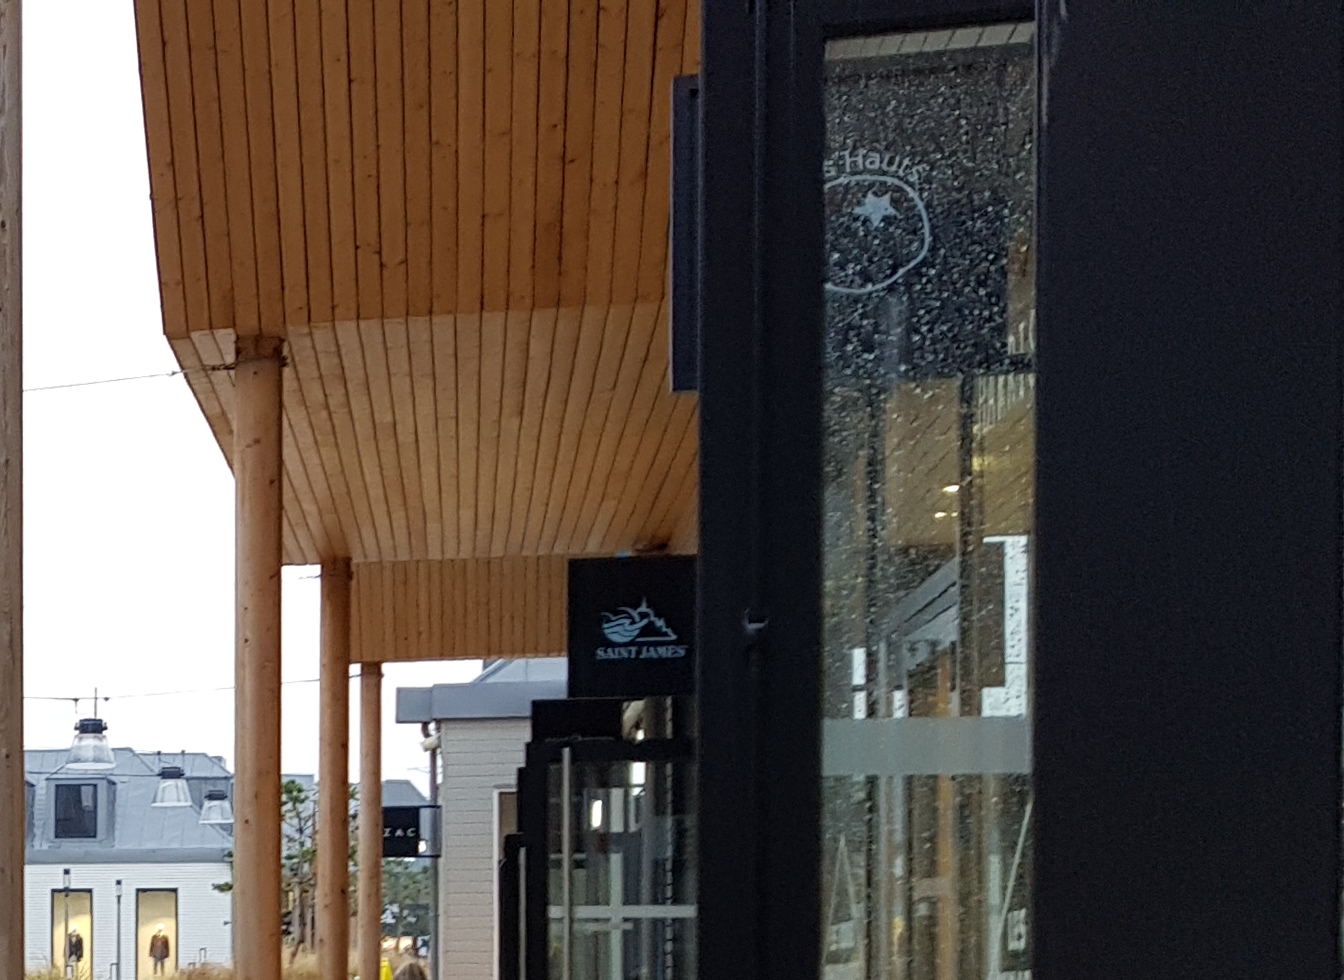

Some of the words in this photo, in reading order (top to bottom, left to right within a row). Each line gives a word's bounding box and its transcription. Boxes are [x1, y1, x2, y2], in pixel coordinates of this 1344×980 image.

[596, 645, 638, 660] SAINT
[639, 644, 688, 659] JAMES
[383, 827, 417, 838] ZAC
